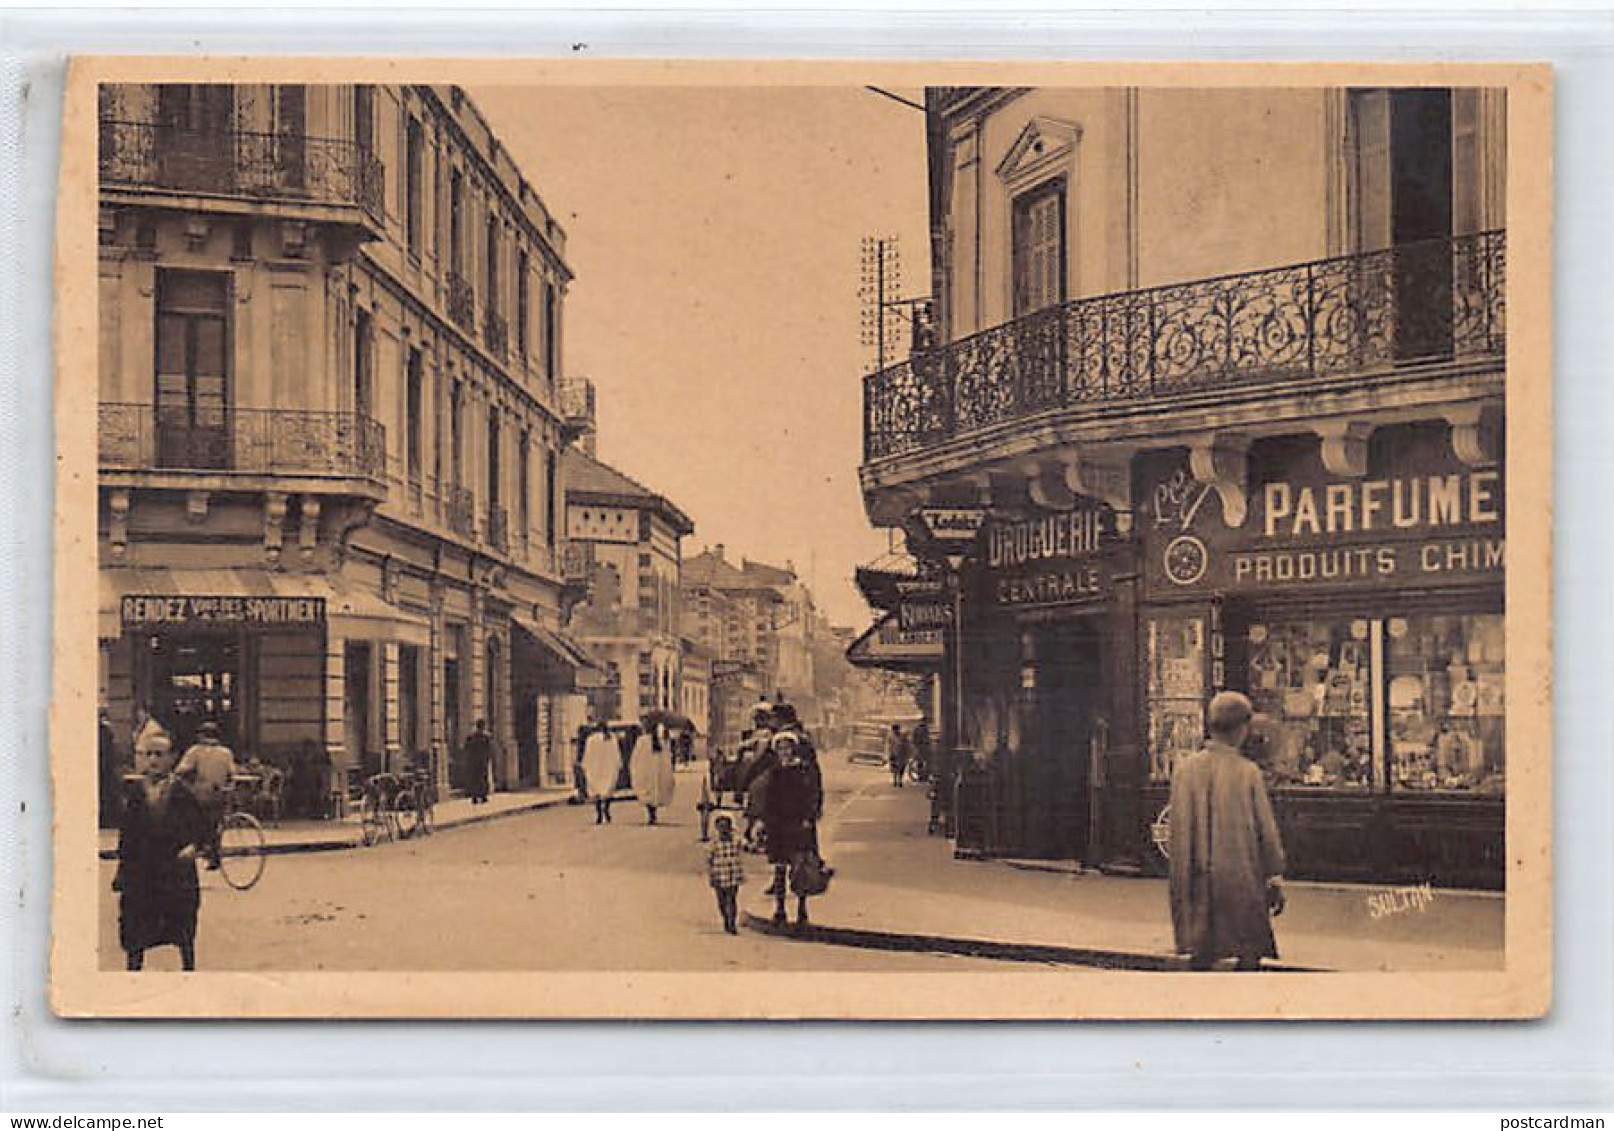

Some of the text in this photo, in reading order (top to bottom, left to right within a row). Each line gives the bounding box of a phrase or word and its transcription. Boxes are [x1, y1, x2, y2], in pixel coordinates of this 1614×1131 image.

[1263, 471, 1497, 536] PARFUME
[1234, 546, 1396, 583] PRODUITS
[999, 569, 1099, 602] CENTRALE
[123, 598, 187, 621] RENDEZ
